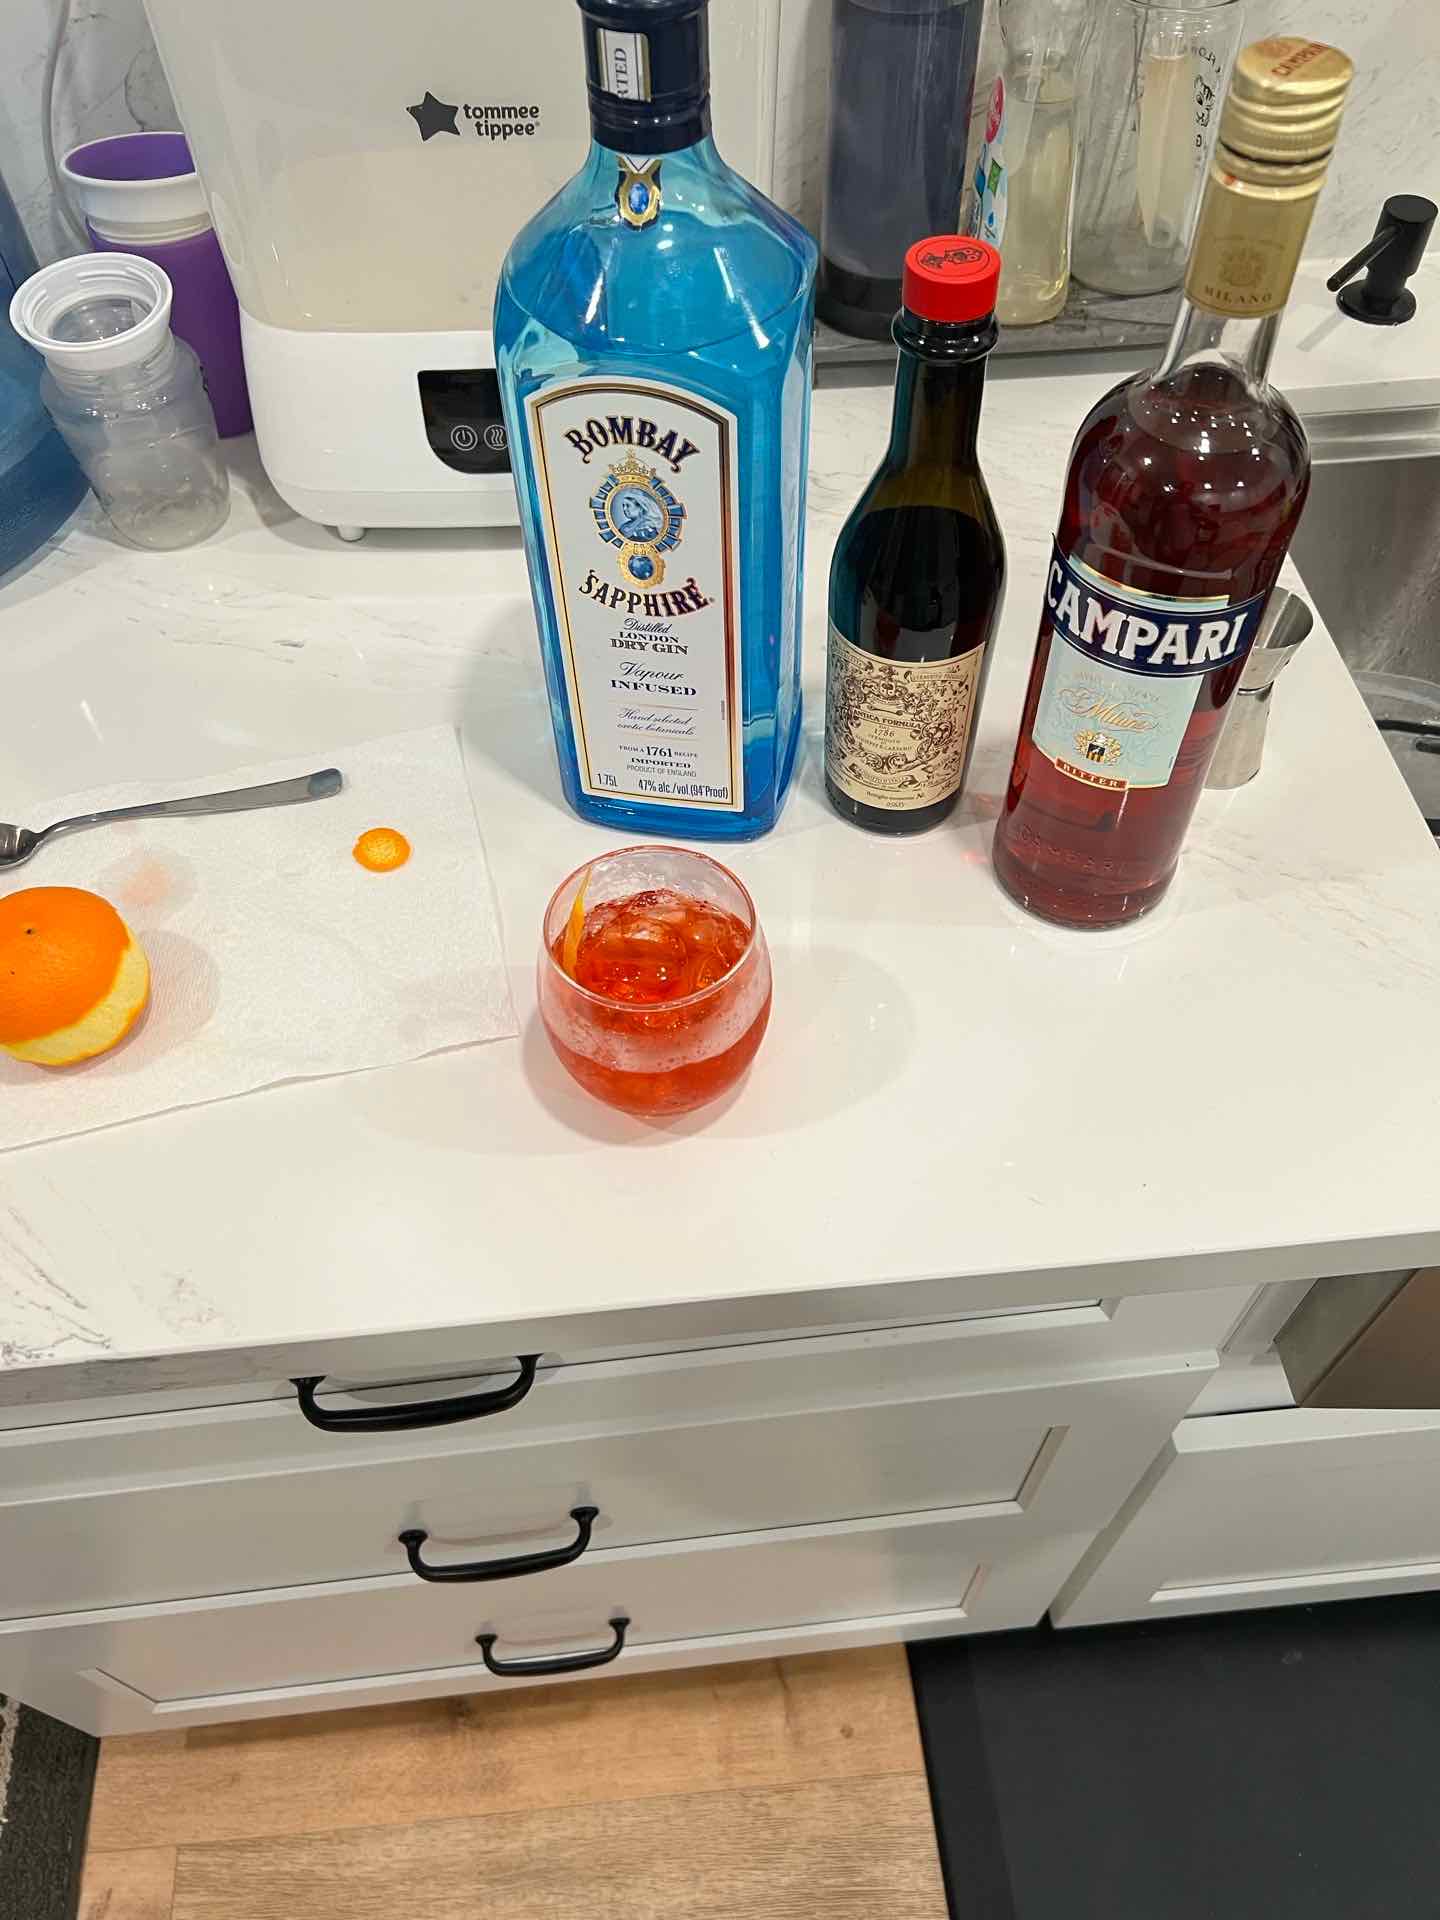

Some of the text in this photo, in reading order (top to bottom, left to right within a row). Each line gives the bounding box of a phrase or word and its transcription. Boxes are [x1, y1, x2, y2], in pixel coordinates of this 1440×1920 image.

[462, 104, 540, 119] tommee
[474, 120, 536, 140] tippee
[564, 416, 701, 473] BOMBAY
[578, 569, 709, 617] SAPPHIRE
[1047, 560, 1248, 666] CAMPARI
[623, 617, 673, 634] Distilled
[619, 631, 680, 644] LONDON
[610, 638, 689, 655] DRY GIN
[619, 661, 685, 681] Vapour
[610, 679, 697, 696] INFUSED
[854, 709, 880, 722] ANTICA
[646, 746, 673, 757] 1761
[631, 757, 691, 769] IMPORTED
[597, 772, 618, 788] 1.75L
[1062, 763, 1120, 788] BITTER
[638, 779, 657, 793] 47%
